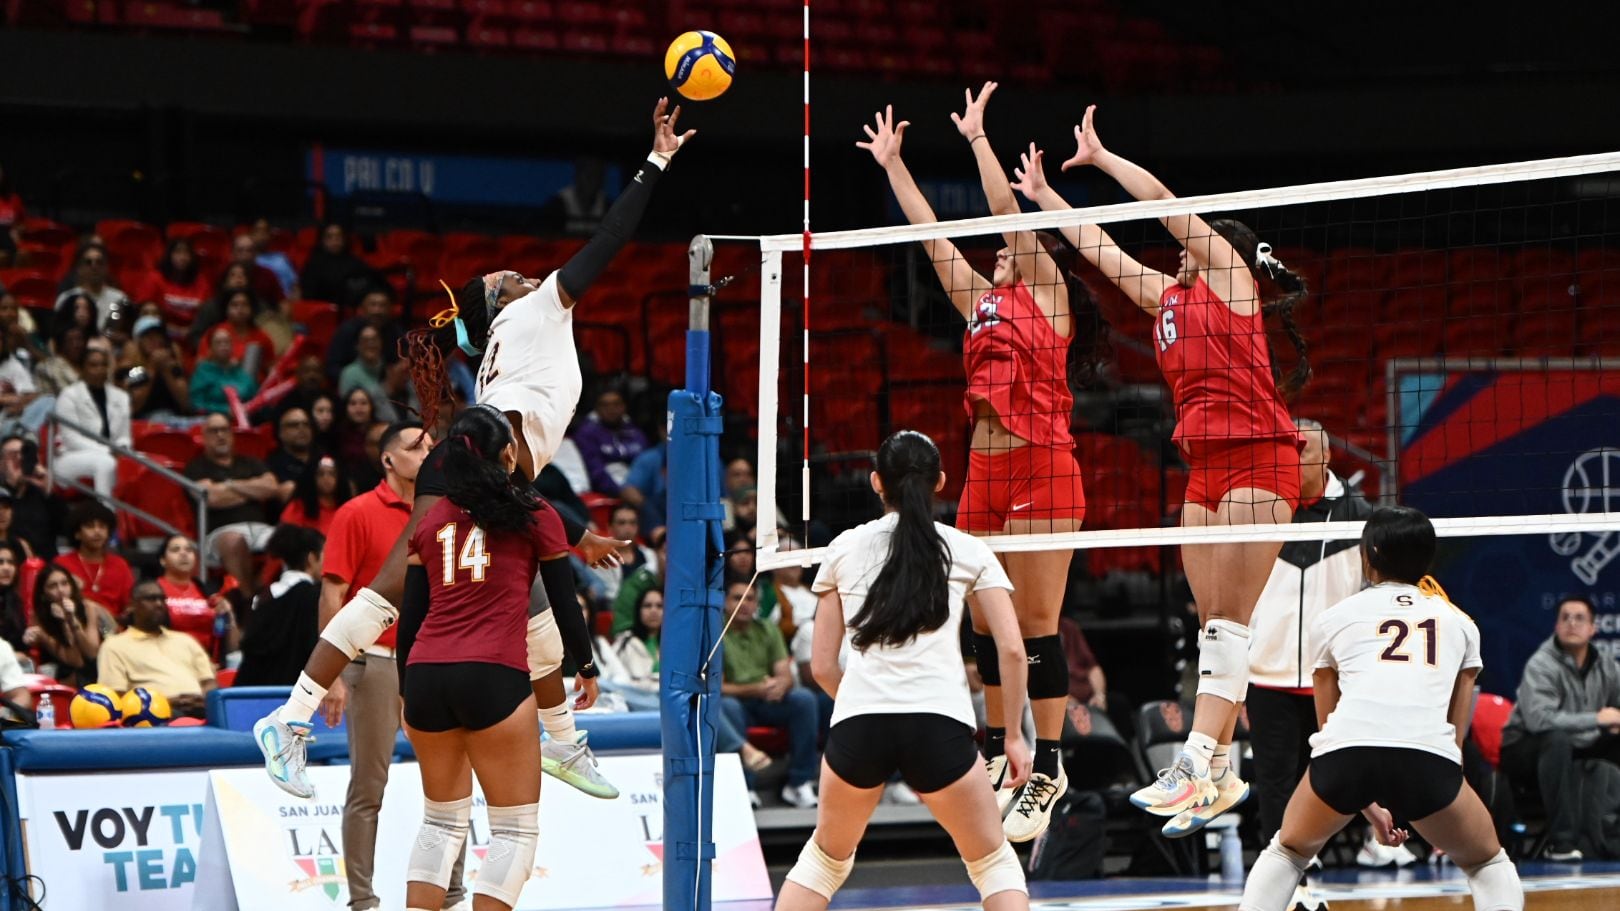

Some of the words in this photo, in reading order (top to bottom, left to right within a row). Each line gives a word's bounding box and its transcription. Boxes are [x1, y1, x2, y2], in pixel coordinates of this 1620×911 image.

[1156, 309, 1178, 352] 16
[436, 522, 491, 586] 14
[1396, 595, 1413, 606] S
[1377, 617, 1439, 668] 21
[279, 806, 309, 818] SAN
[313, 805, 344, 817] JUA
[629, 794, 658, 804] SAN
[52, 806, 155, 851] VOY
